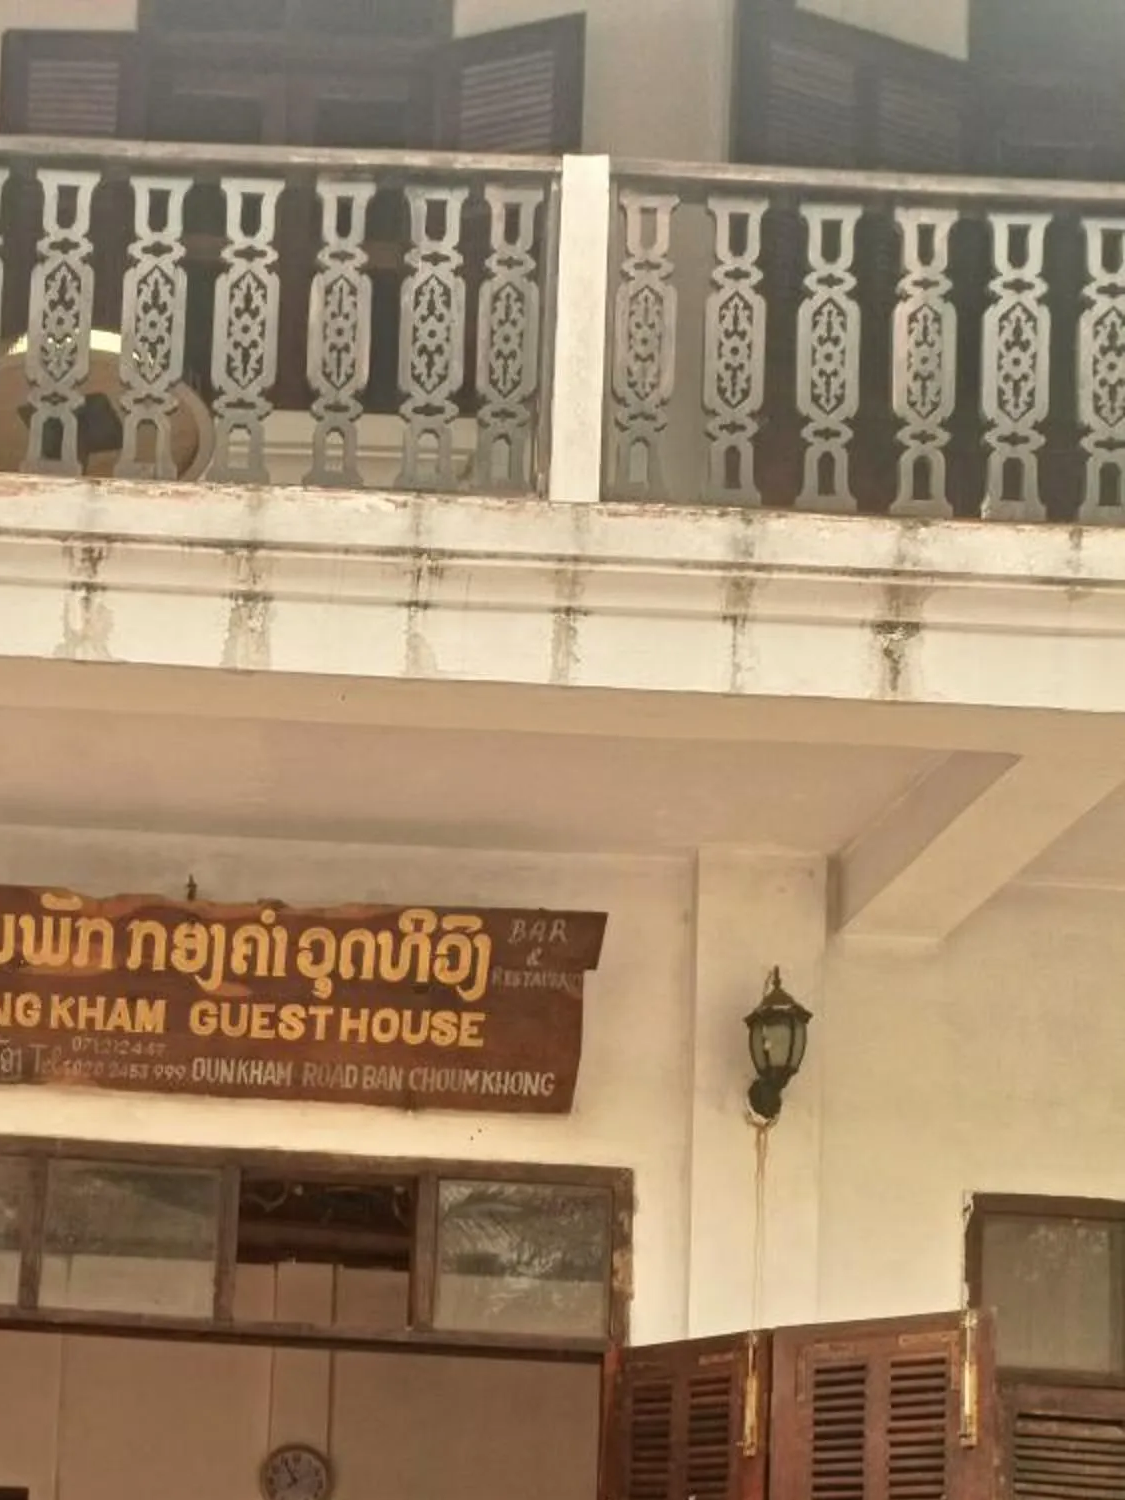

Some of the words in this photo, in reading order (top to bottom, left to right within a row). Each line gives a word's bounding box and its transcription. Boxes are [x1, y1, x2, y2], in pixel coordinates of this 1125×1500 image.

[507, 918, 569, 946] BAR
[50, 995, 167, 1034] KHAM
[189, 1000, 334, 1041] GUEST
[338, 1006, 487, 1048] HOUSE
[191, 1057, 293, 1087] OUNKHAM
[301, 1061, 358, 1089] ROAD
[362, 1065, 404, 1091] BAN
